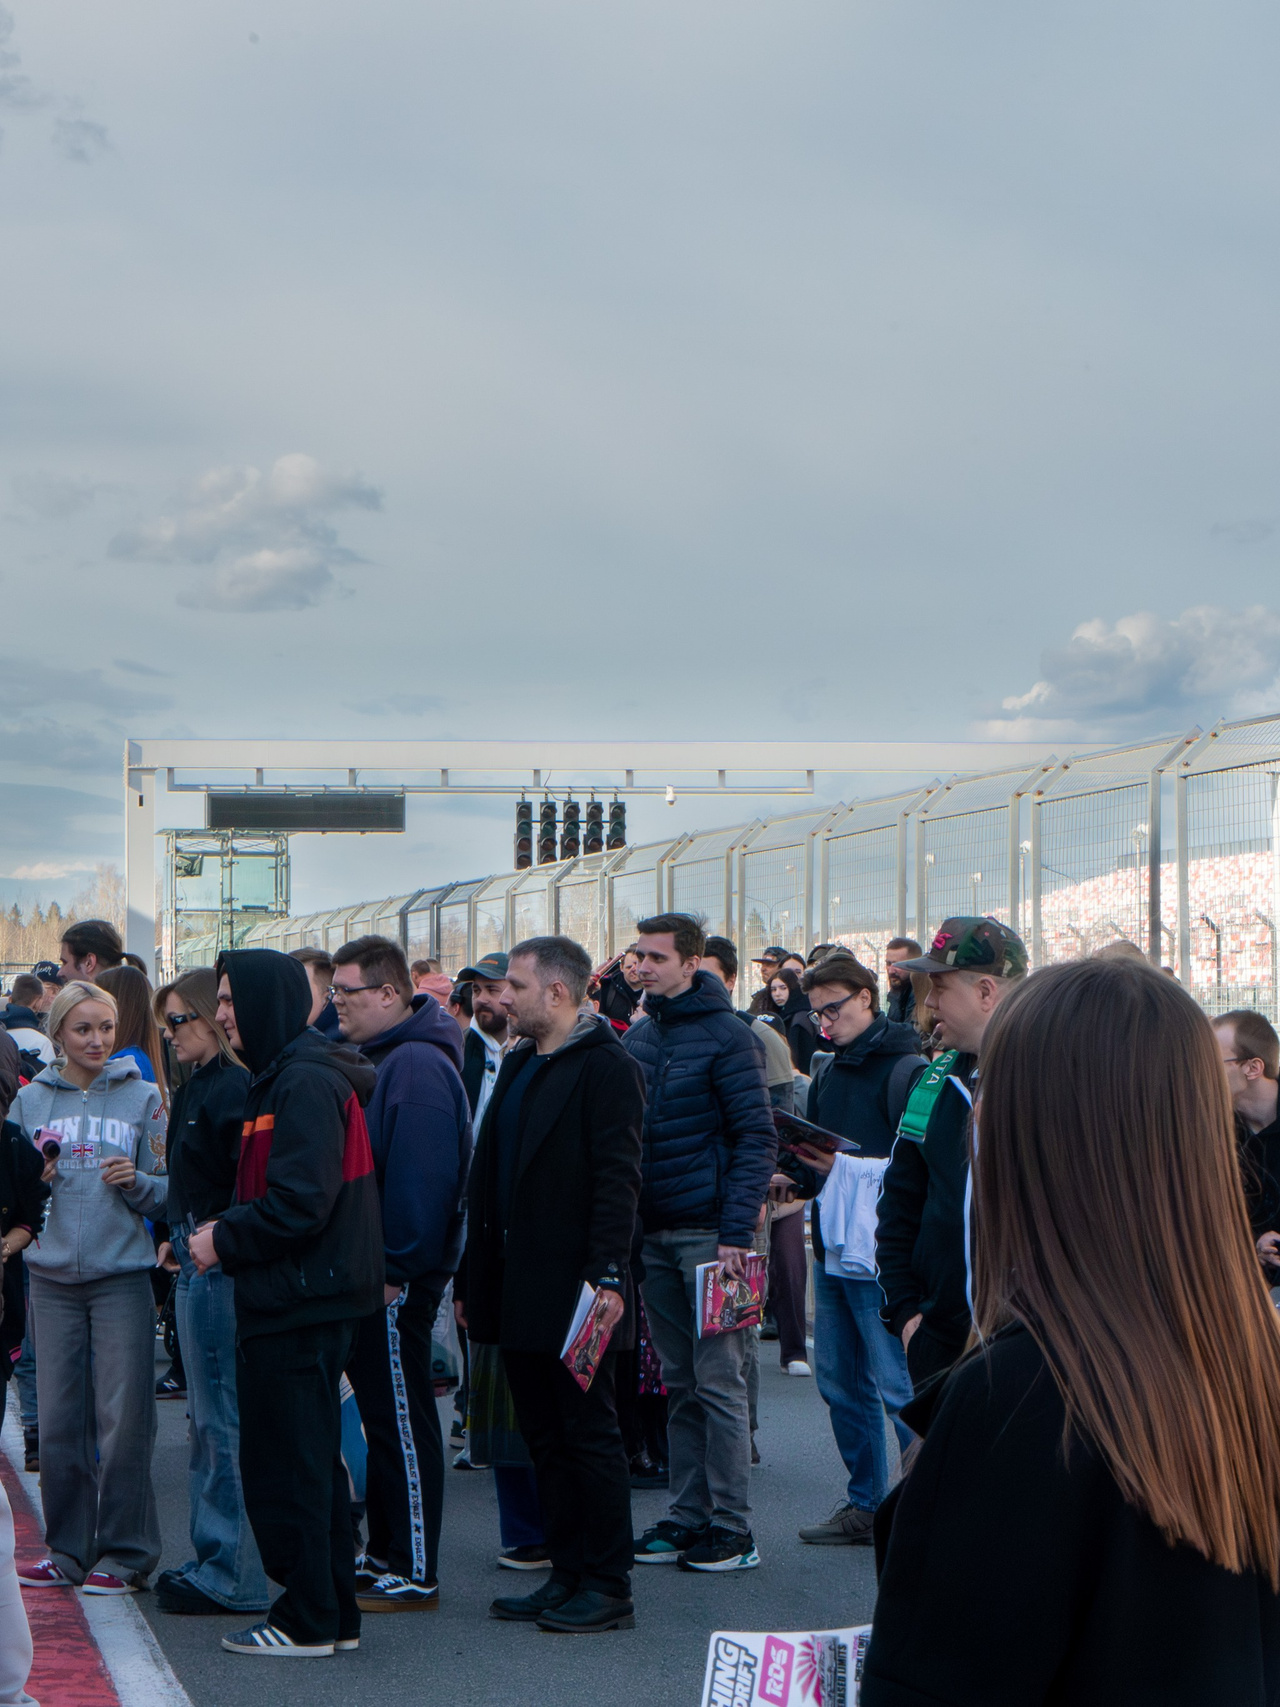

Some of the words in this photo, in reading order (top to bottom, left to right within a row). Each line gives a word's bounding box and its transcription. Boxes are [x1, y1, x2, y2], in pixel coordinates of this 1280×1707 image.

[40, 1115, 136, 1158] ONDON
[765, 1645, 789, 1699] RDS
[837, 1644, 847, 1675] LIMITS
